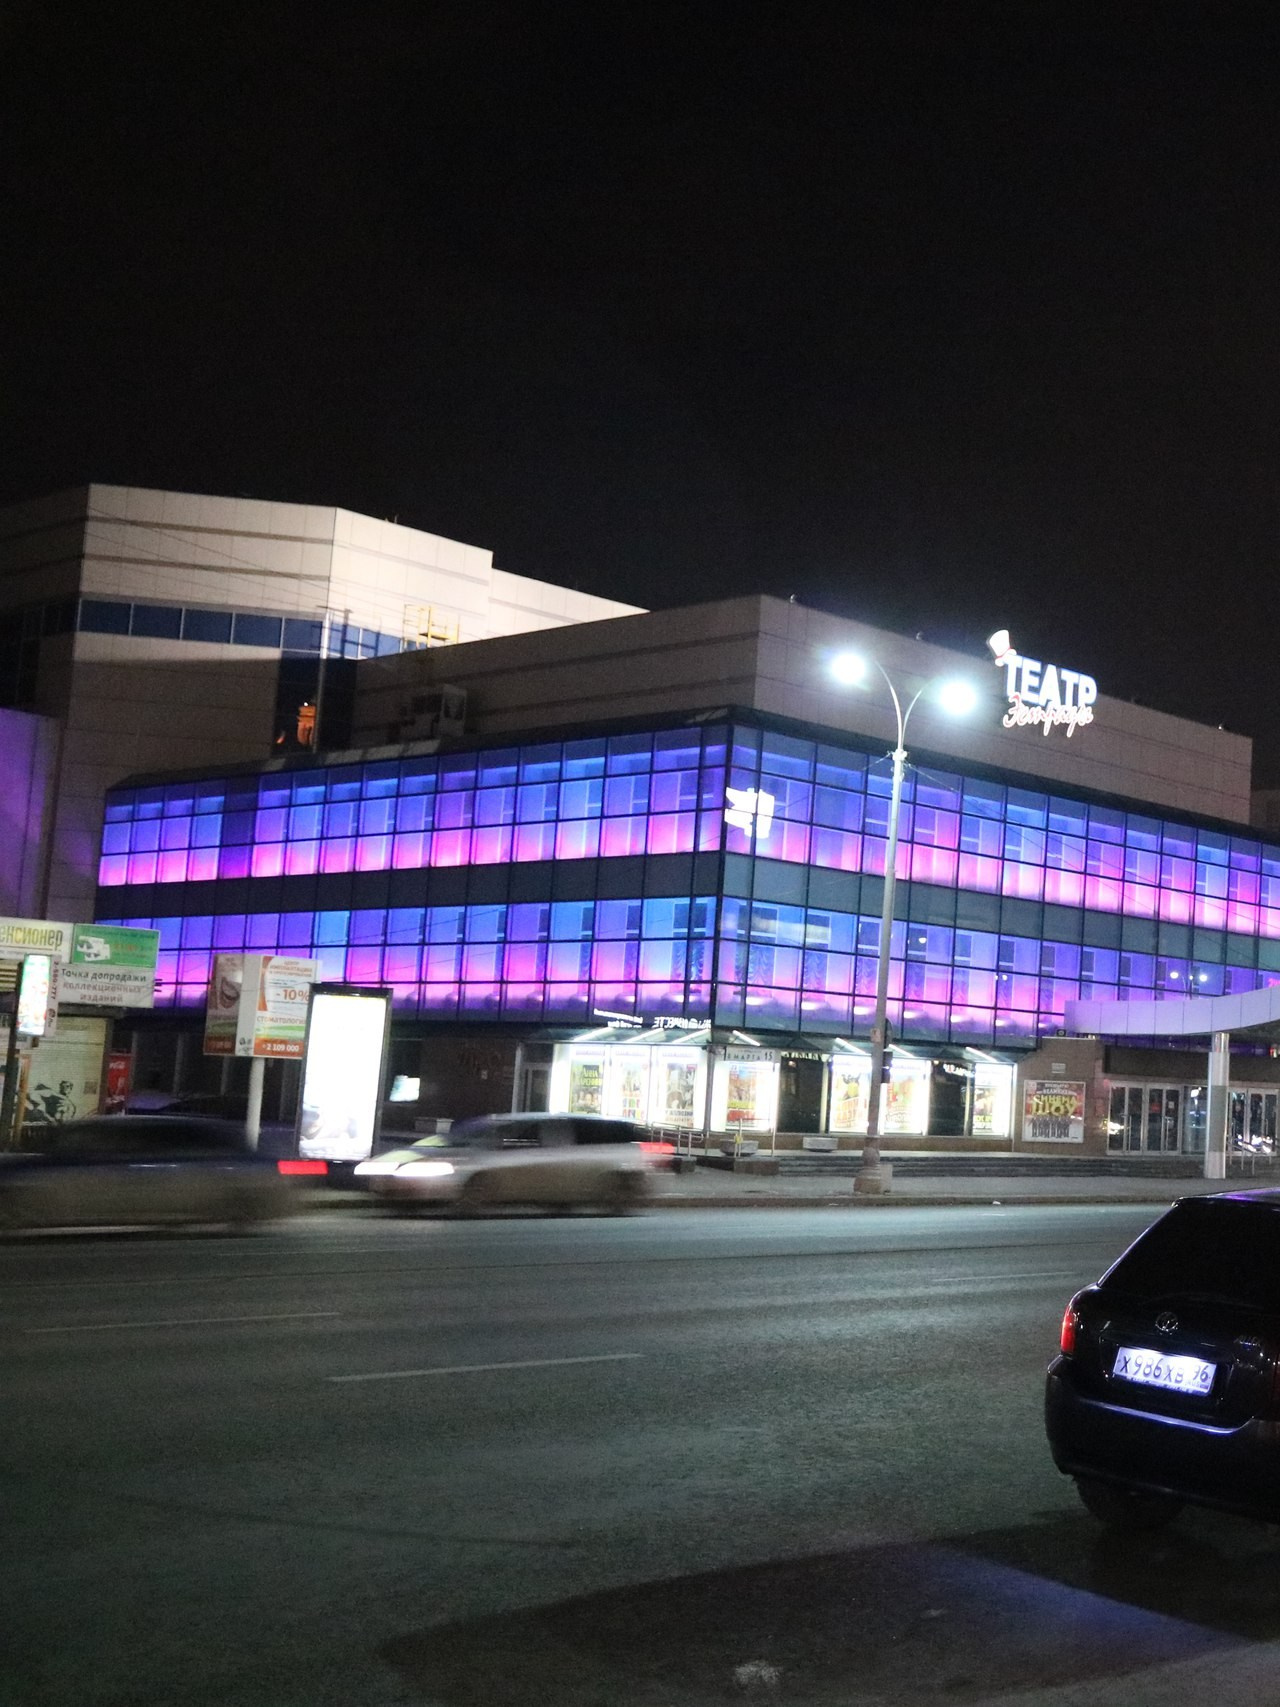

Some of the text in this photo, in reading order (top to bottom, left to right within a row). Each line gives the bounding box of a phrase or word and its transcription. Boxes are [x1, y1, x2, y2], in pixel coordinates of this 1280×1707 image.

[1003, 653, 1098, 708] ТЕАТР
[61, 968, 147, 983] Точка допродажи
[62, 981, 142, 993] коллекционных
[79, 993, 124, 1003] изданий
